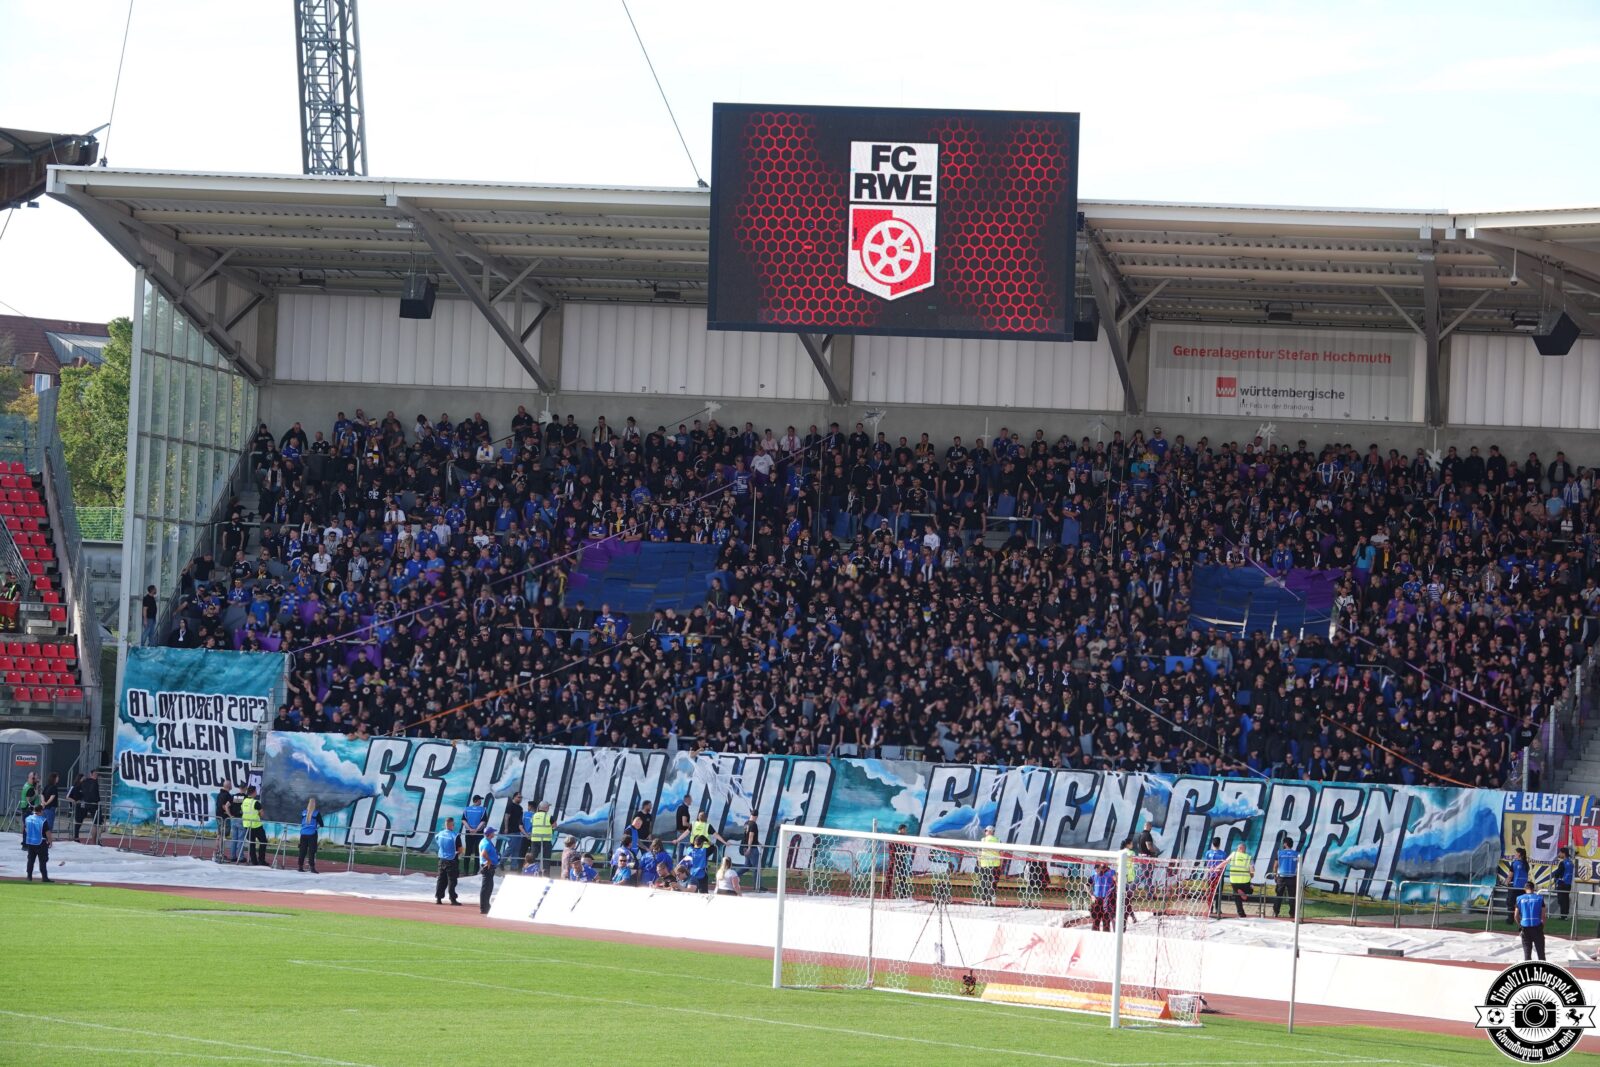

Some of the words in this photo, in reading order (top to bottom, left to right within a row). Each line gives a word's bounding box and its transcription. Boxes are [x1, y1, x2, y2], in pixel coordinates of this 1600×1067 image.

[871, 145, 917, 172] FC
[854, 173, 933, 201] RWE
[1173, 345, 1275, 361] Generalagentur
[1278, 349, 1320, 362] Stefan
[1323, 351, 1391, 364] Hochmuth
[1240, 385, 1345, 400] württembergische
[129, 690, 154, 718] 01.
[158, 692, 224, 724] OKTOBER
[158, 722, 230, 753] ALLEIN
[345, 737, 456, 851] ES
[1521, 792, 1581, 814] BLEIBT
